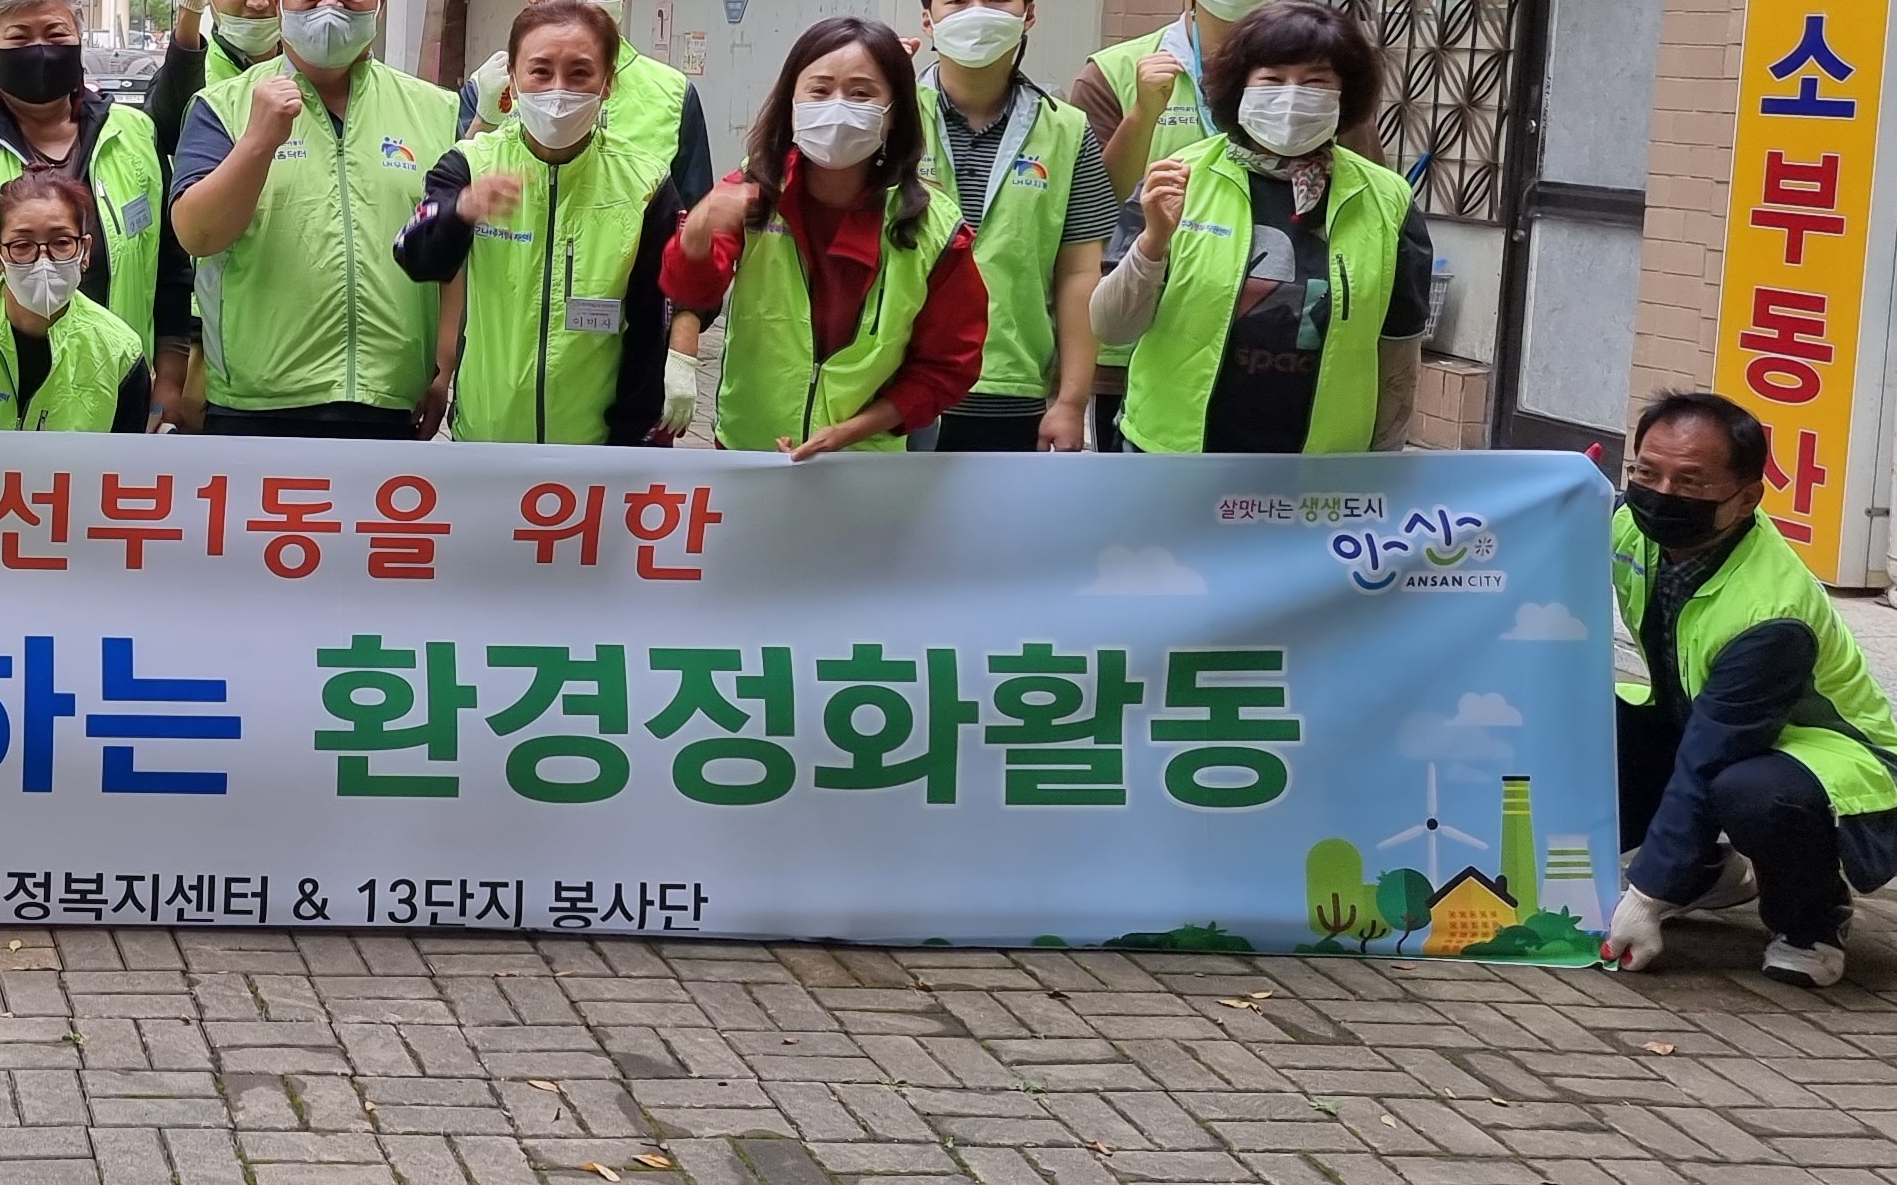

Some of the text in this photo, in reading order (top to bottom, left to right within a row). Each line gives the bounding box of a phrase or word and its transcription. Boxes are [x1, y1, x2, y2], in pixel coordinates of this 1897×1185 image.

[513, 481, 724, 581] 위한
[1219, 497, 1383, 522] 살맛나는 생생도시
[1332, 509, 1482, 591] 안산
[1406, 575, 1502, 588] ANSAN CITY
[313, 633, 1302, 808] 환경정화활동
[292, 877, 331, 922] &
[357, 877, 522, 930] 13단지
[548, 880, 709, 932] 봉사단
